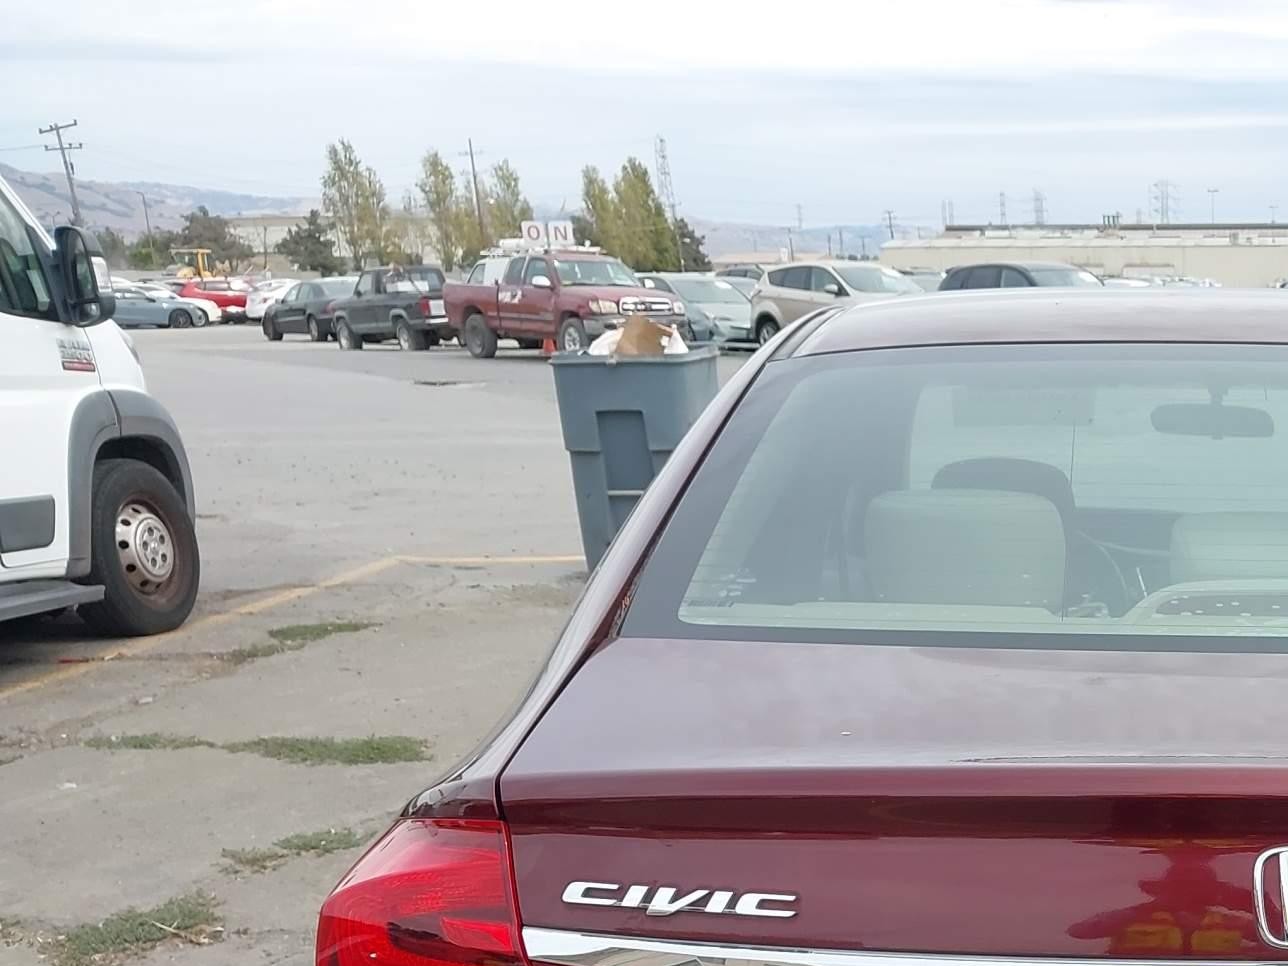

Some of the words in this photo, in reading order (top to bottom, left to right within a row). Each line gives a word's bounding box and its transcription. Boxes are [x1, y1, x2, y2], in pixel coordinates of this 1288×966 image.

[527, 225, 540, 240] O
[553, 225, 568, 241] N
[561, 881, 798, 918] CIVIC
